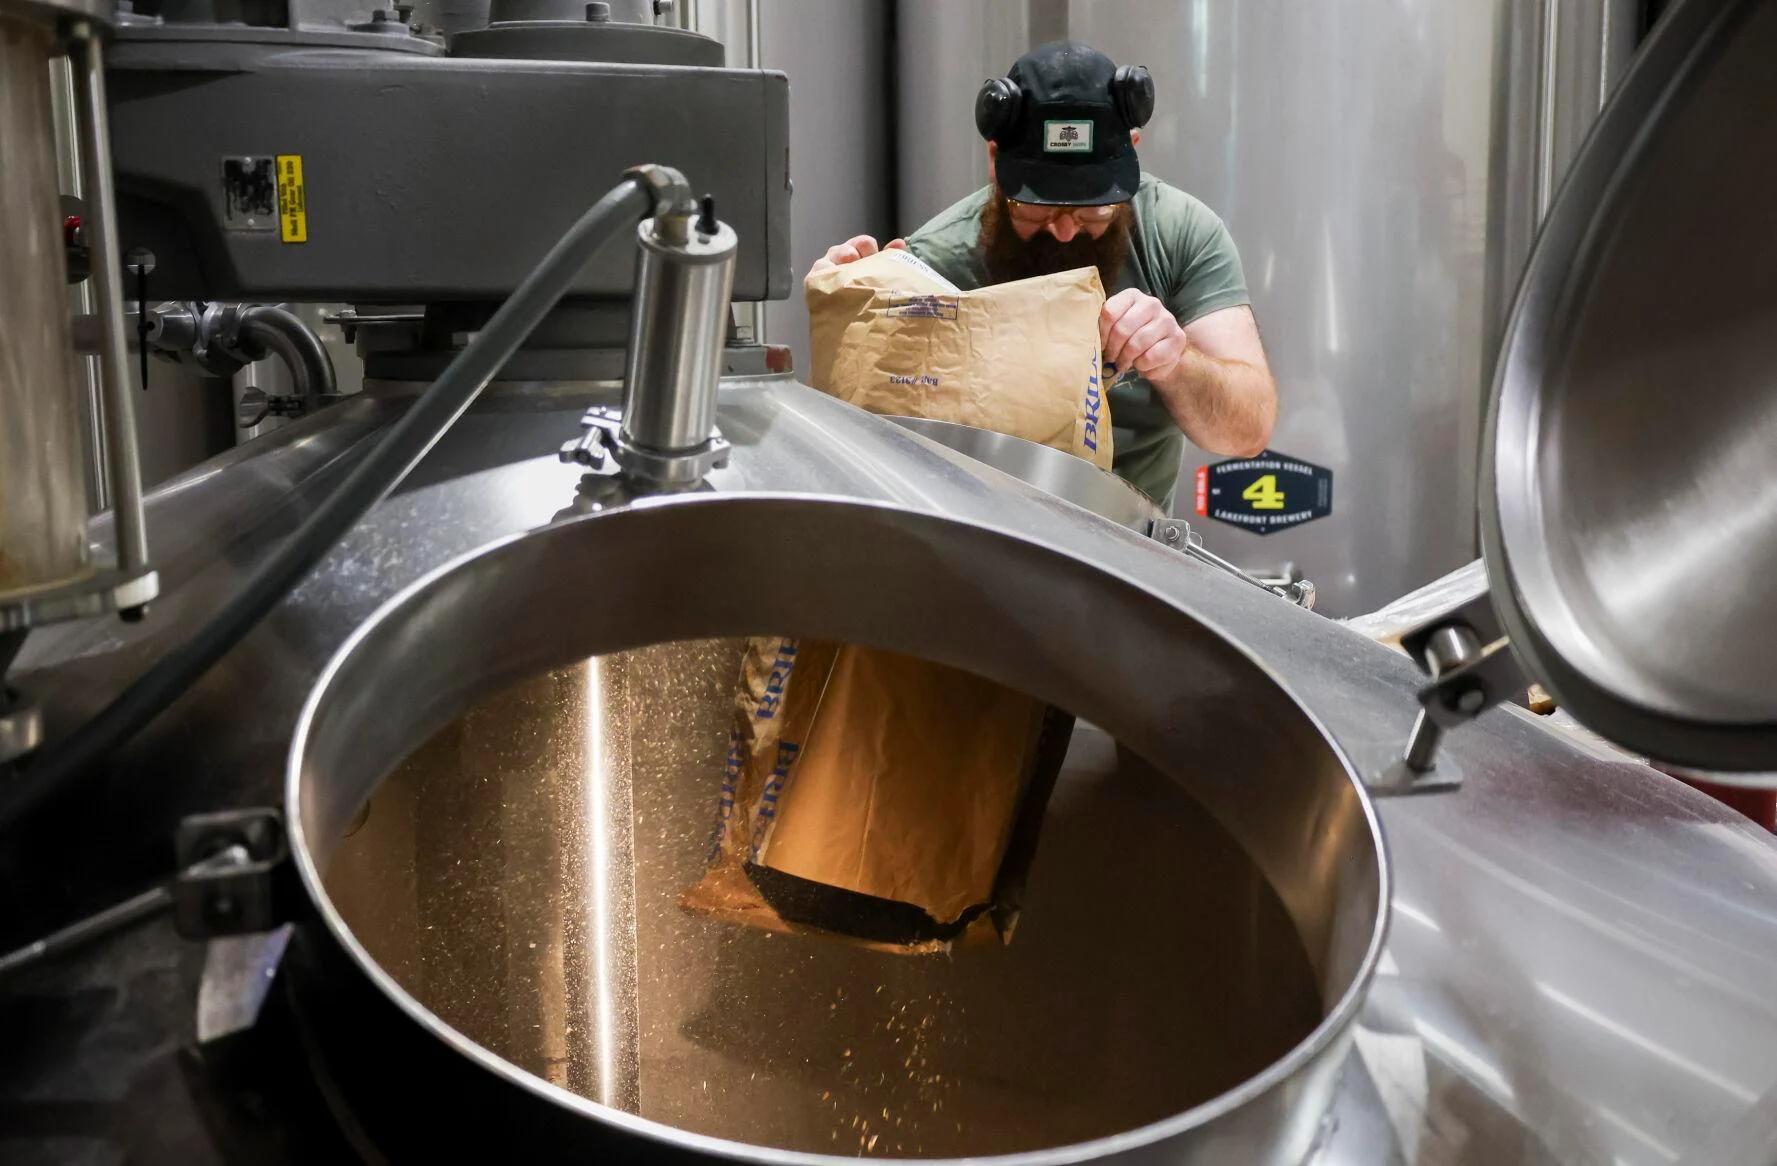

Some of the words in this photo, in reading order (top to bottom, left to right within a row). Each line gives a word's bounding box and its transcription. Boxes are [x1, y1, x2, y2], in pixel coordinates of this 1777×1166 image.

[1216, 461, 1281, 474] FERMENTATION
[1283, 462, 1313, 476] VESSEL
[1242, 474, 1285, 509] 4
[1214, 509, 1267, 524] LAKEFRONT
[1269, 510, 1312, 524] BREWERY
